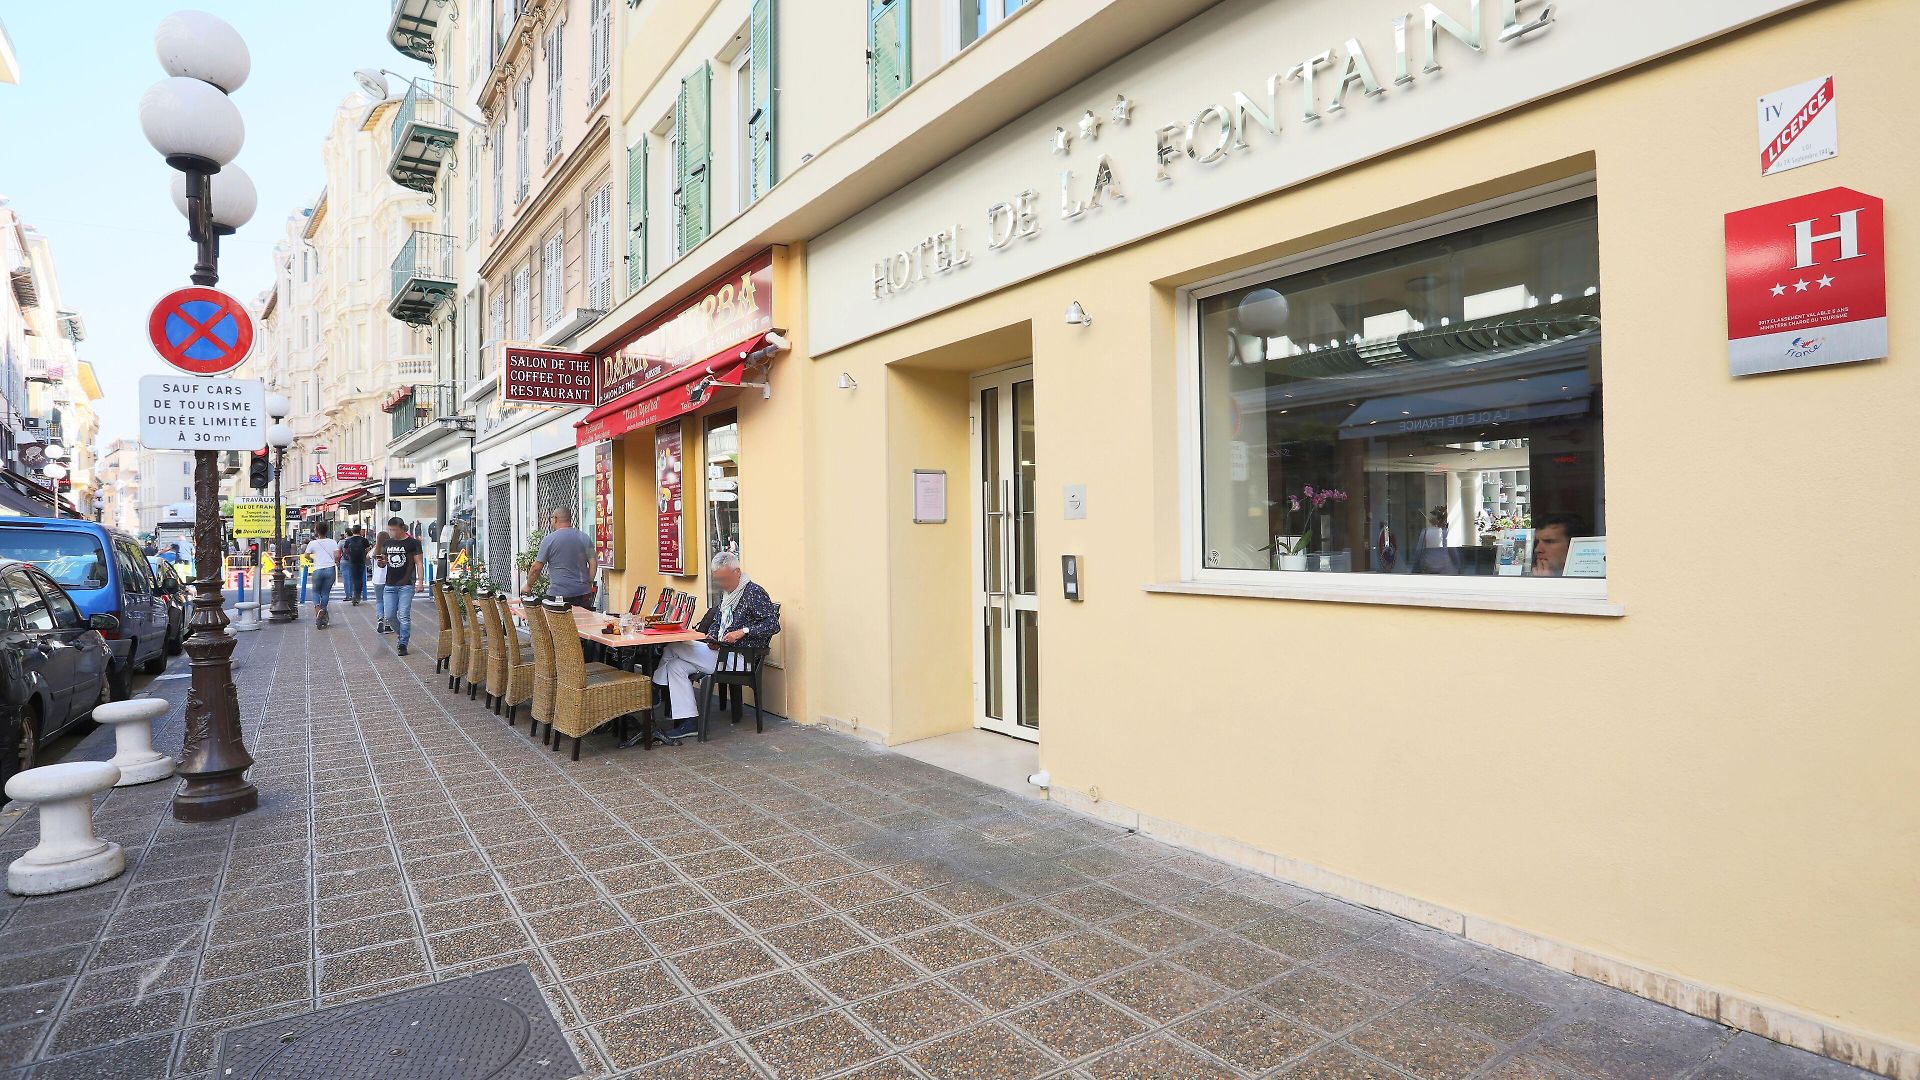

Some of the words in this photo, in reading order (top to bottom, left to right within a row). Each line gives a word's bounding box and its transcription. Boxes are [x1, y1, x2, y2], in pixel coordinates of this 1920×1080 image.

[1765, 102, 1782, 121] IV
[1768, 87, 1827, 162] LICENCE
[872, 223, 973, 300] HOTEL
[987, 187, 1041, 250] DE
[1060, 153, 1127, 220] LA
[1787, 207, 1867, 270] H
[1806, 310, 1831, 318] VALABLE
[1819, 313, 1848, 322] TOURISME
[510, 355, 547, 369] SALON
[551, 358, 565, 370] DE
[569, 360, 590, 372] THÉ
[510, 370, 554, 384] COFFEE
[557, 373, 572, 385] TO
[575, 375, 590, 386] GO
[162, 383, 199, 393] SAUF
[207, 385, 242, 395] CARS
[510, 384, 590, 400] RESTAURANT
[154, 399, 171, 409] DE
[179, 400, 251, 411] TOURISME
[148, 414, 196, 426] DURÉE
[202, 416, 257, 427] LIMITÉE
